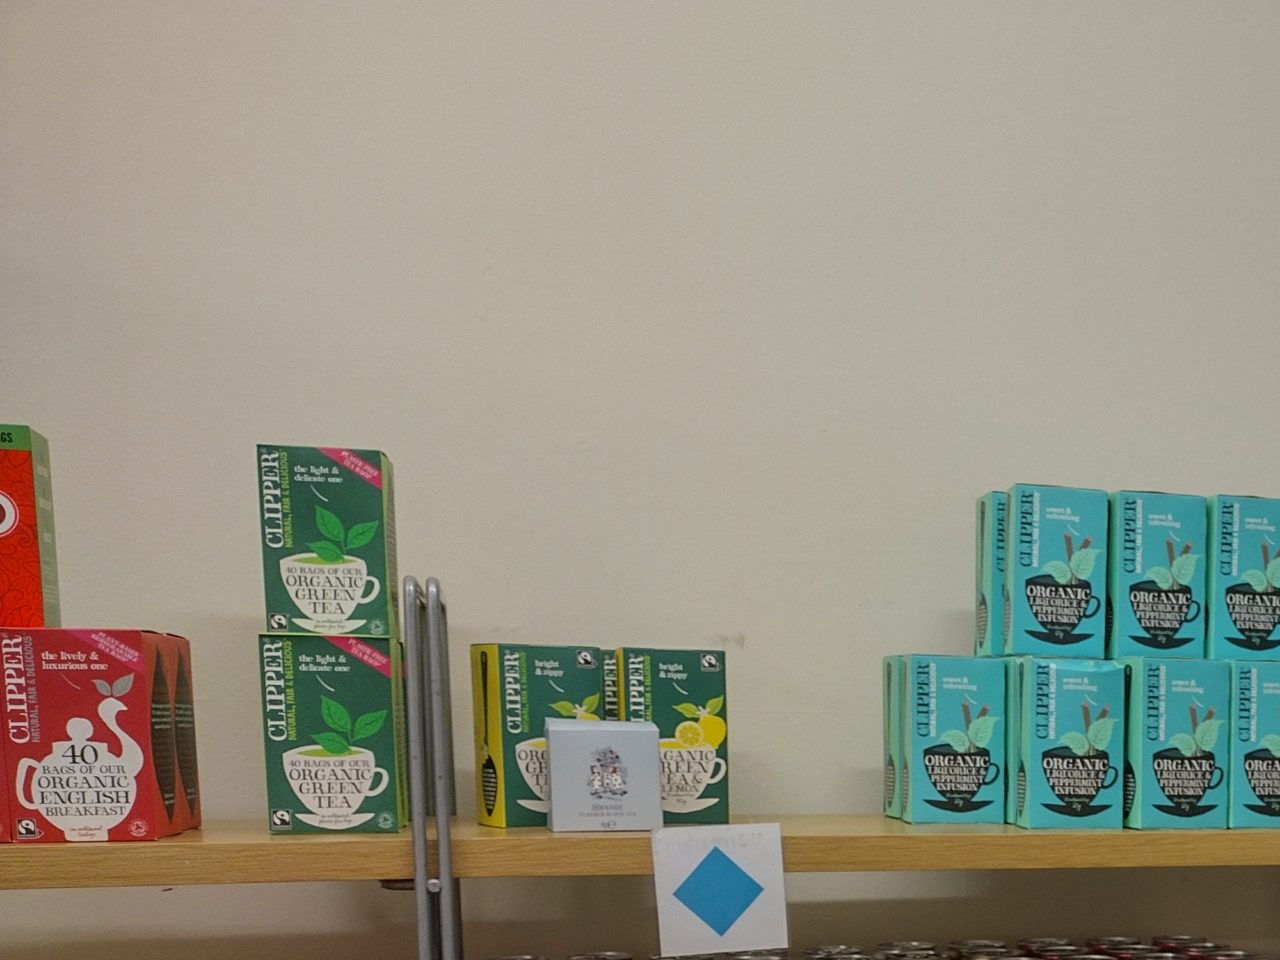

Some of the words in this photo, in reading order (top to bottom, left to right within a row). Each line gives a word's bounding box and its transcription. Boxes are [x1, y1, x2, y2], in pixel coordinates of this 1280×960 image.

[262, 452, 284, 548] CLIPPER
[1019, 492, 1034, 567] CLIPPER
[286, 575, 364, 588] ORGANIC
[295, 588, 356, 601] GREEN
[1026, 585, 1091, 600] ORGANIC
[1130, 591, 1191, 604] ORGANIC
[308, 602, 346, 615] TEA
[41, 651, 57, 660] the
[60, 651, 87, 662] lively
[42, 661, 88, 670] luxurious
[91, 662, 108, 671] one
[2, 635, 30, 744] CLIPPER
[263, 640, 288, 741] CLIPPER
[504, 650, 524, 733] CLIPPER
[917, 663, 931, 737] CLIPPER
[1035, 664, 1050, 739] CLIPPER
[62, 744, 98, 765] 40
[924, 754, 990, 767] ORGANIC
[43, 766, 76, 774] BAGS
[80, 766, 94, 774] OF
[99, 765, 126, 774] OUR
[1043, 757, 1109, 770] ORGANIC
[1153, 759, 1215, 772] ORGANIC
[289, 768, 372, 781] ORGANIC
[928, 766, 978, 776] LIQUORICE
[38, 776, 130, 789] ORGANIC
[931, 775, 984, 784] PEPPERMINT
[299, 781, 363, 794] GREEN
[936, 782, 978, 791] INFUSION
[39, 790, 130, 805] ENGLISH
[313, 796, 352, 809] TEA
[46, 805, 126, 816] BREAKFAST
